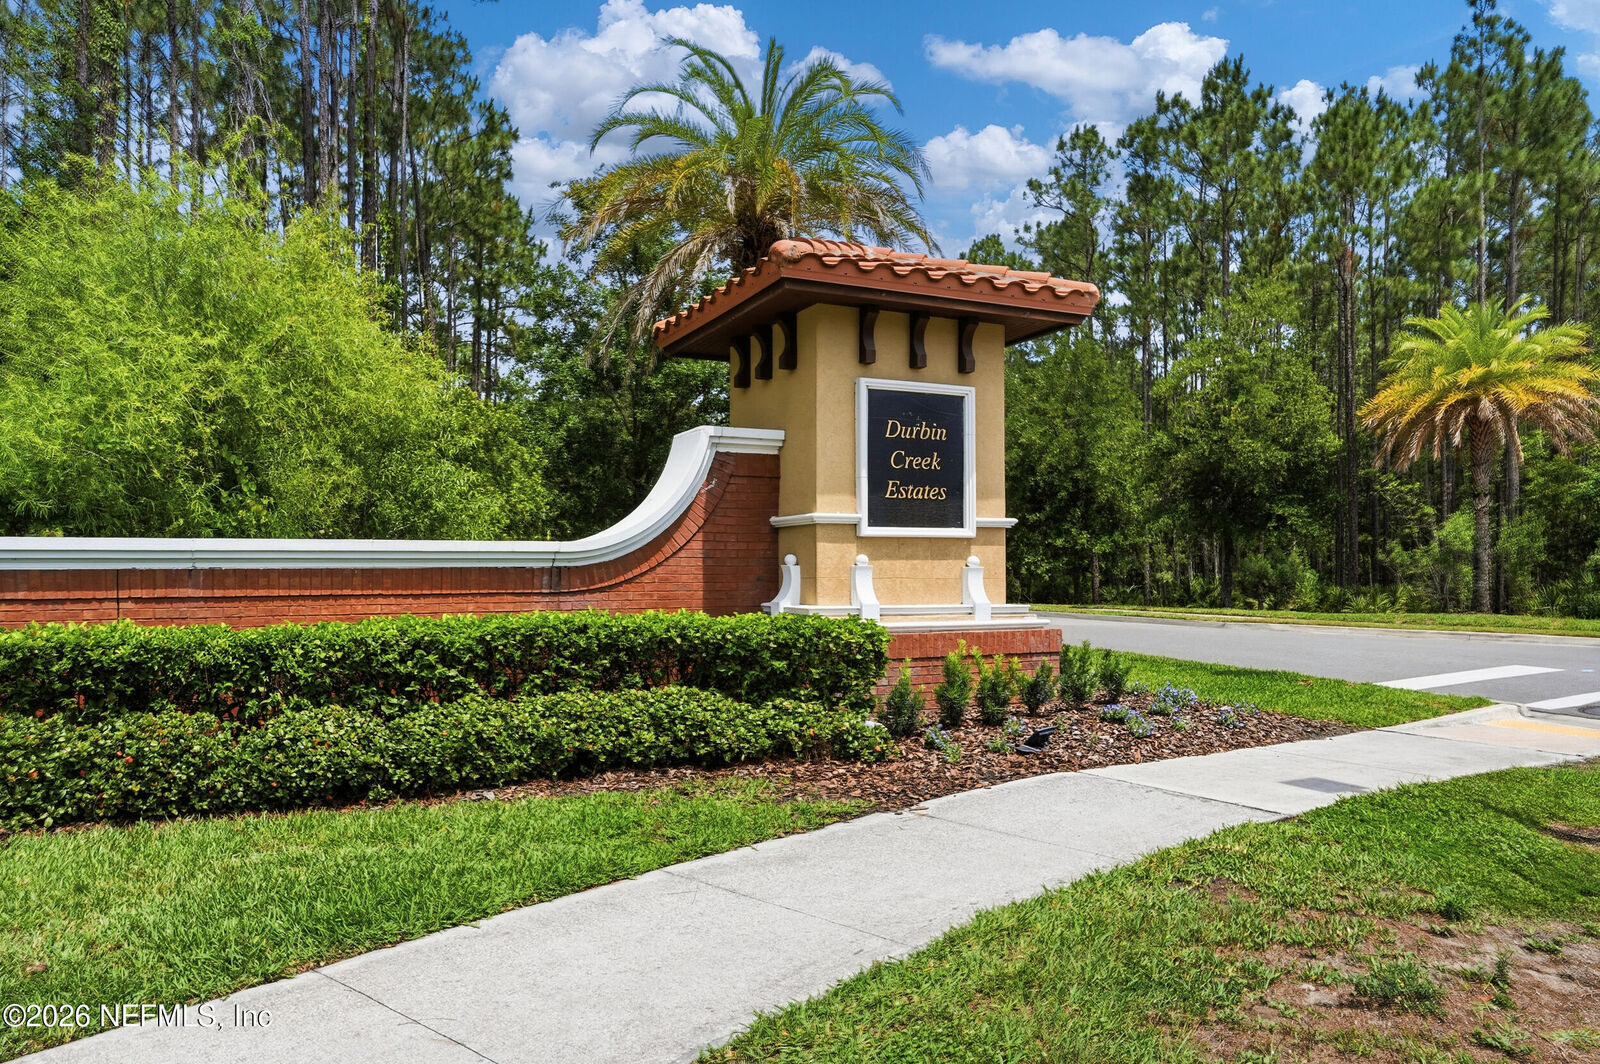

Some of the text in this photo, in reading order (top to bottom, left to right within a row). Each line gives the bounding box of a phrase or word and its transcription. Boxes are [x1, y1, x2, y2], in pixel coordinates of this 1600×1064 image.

[885, 419, 947, 441] Durbin
[890, 450, 941, 470] Creek
[884, 480, 947, 500] Estates
